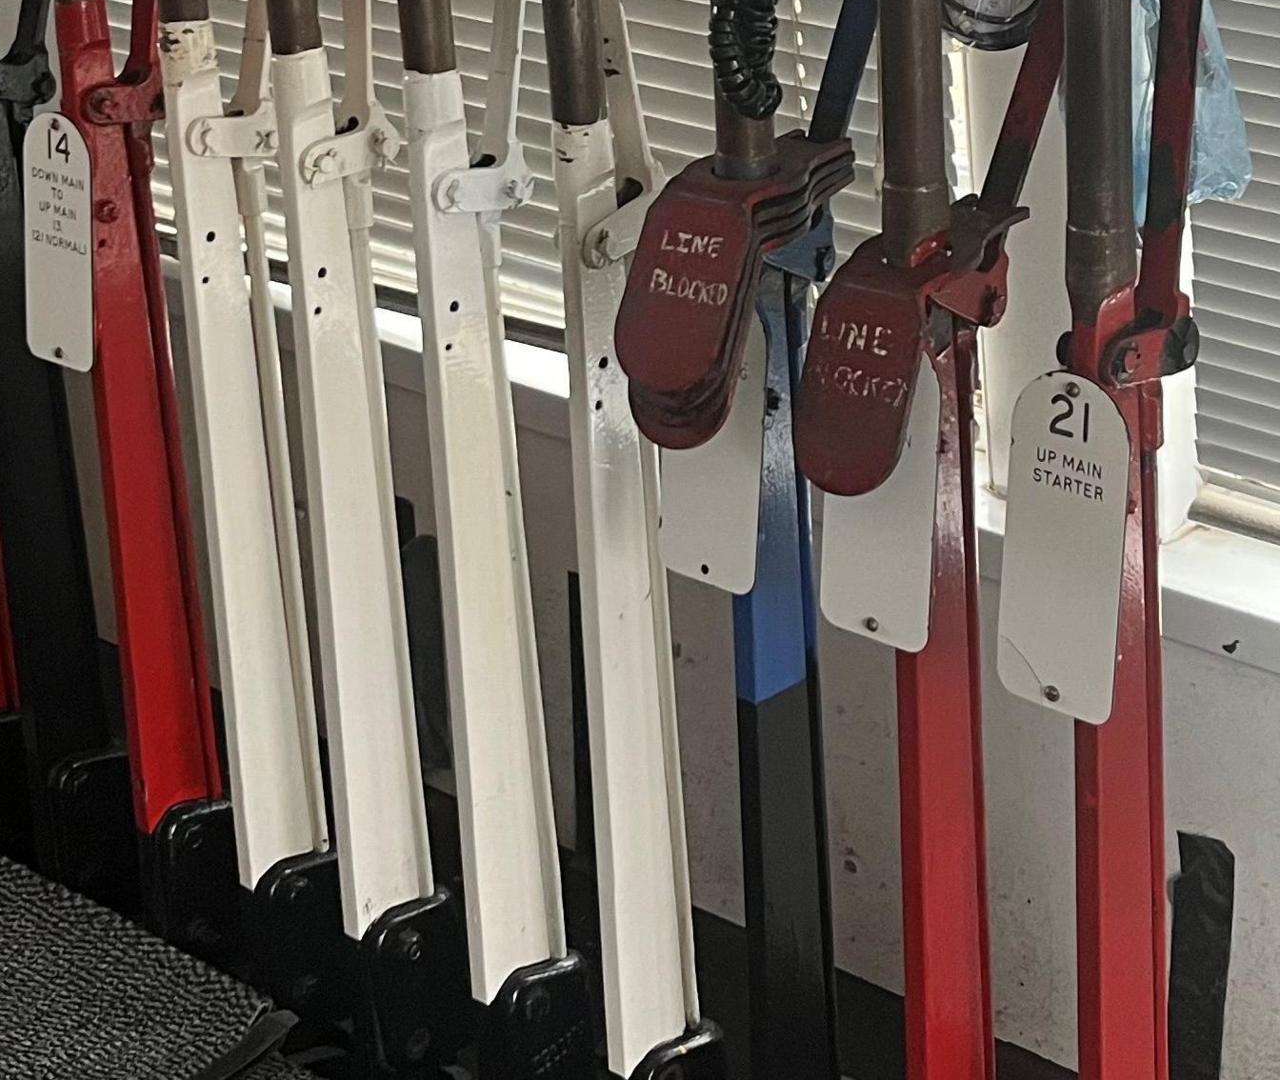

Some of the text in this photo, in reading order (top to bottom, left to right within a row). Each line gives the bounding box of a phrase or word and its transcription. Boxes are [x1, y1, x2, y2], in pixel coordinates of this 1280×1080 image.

[47, 128, 71, 163] 14
[31, 166, 85, 191] DOWN MAIN
[50, 187, 64, 200] TO
[39, 201, 77, 220] UP MAIN
[660, 229, 724, 260] LINE
[649, 268, 729, 306] BLOCKED
[1049, 394, 1089, 443] 21
[1036, 447, 1102, 480] UP MAIN
[1033, 467, 1104, 502] STARTER
